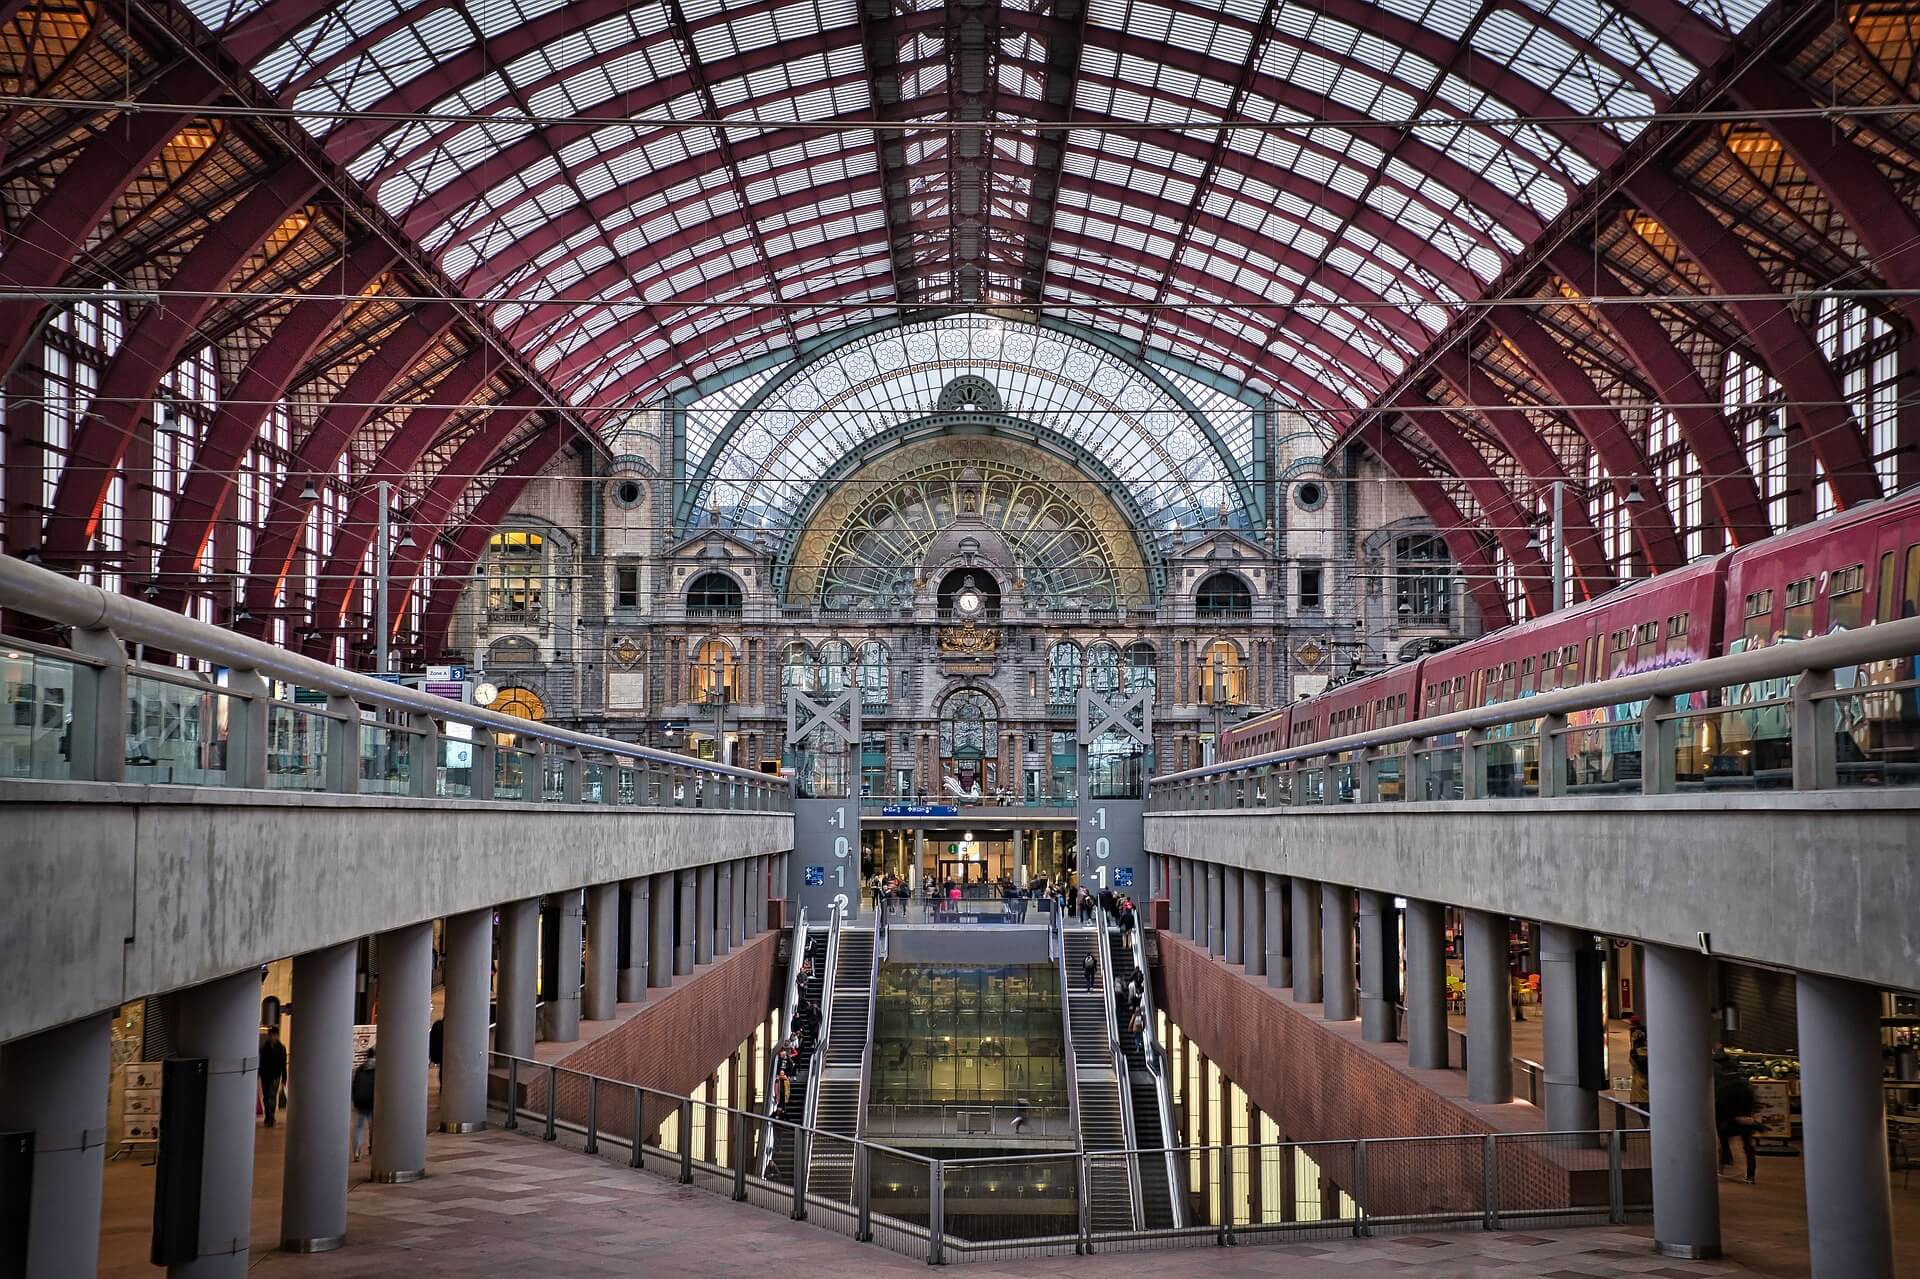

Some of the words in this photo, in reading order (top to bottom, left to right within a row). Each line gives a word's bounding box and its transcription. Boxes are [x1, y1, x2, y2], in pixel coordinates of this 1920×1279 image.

[1630, 623, 1637, 646] 2
[1557, 646, 1563, 667] 2
[454, 670, 461, 678] 3
[834, 836, 849, 858] 0
[1095, 837, 1110, 859] 0
